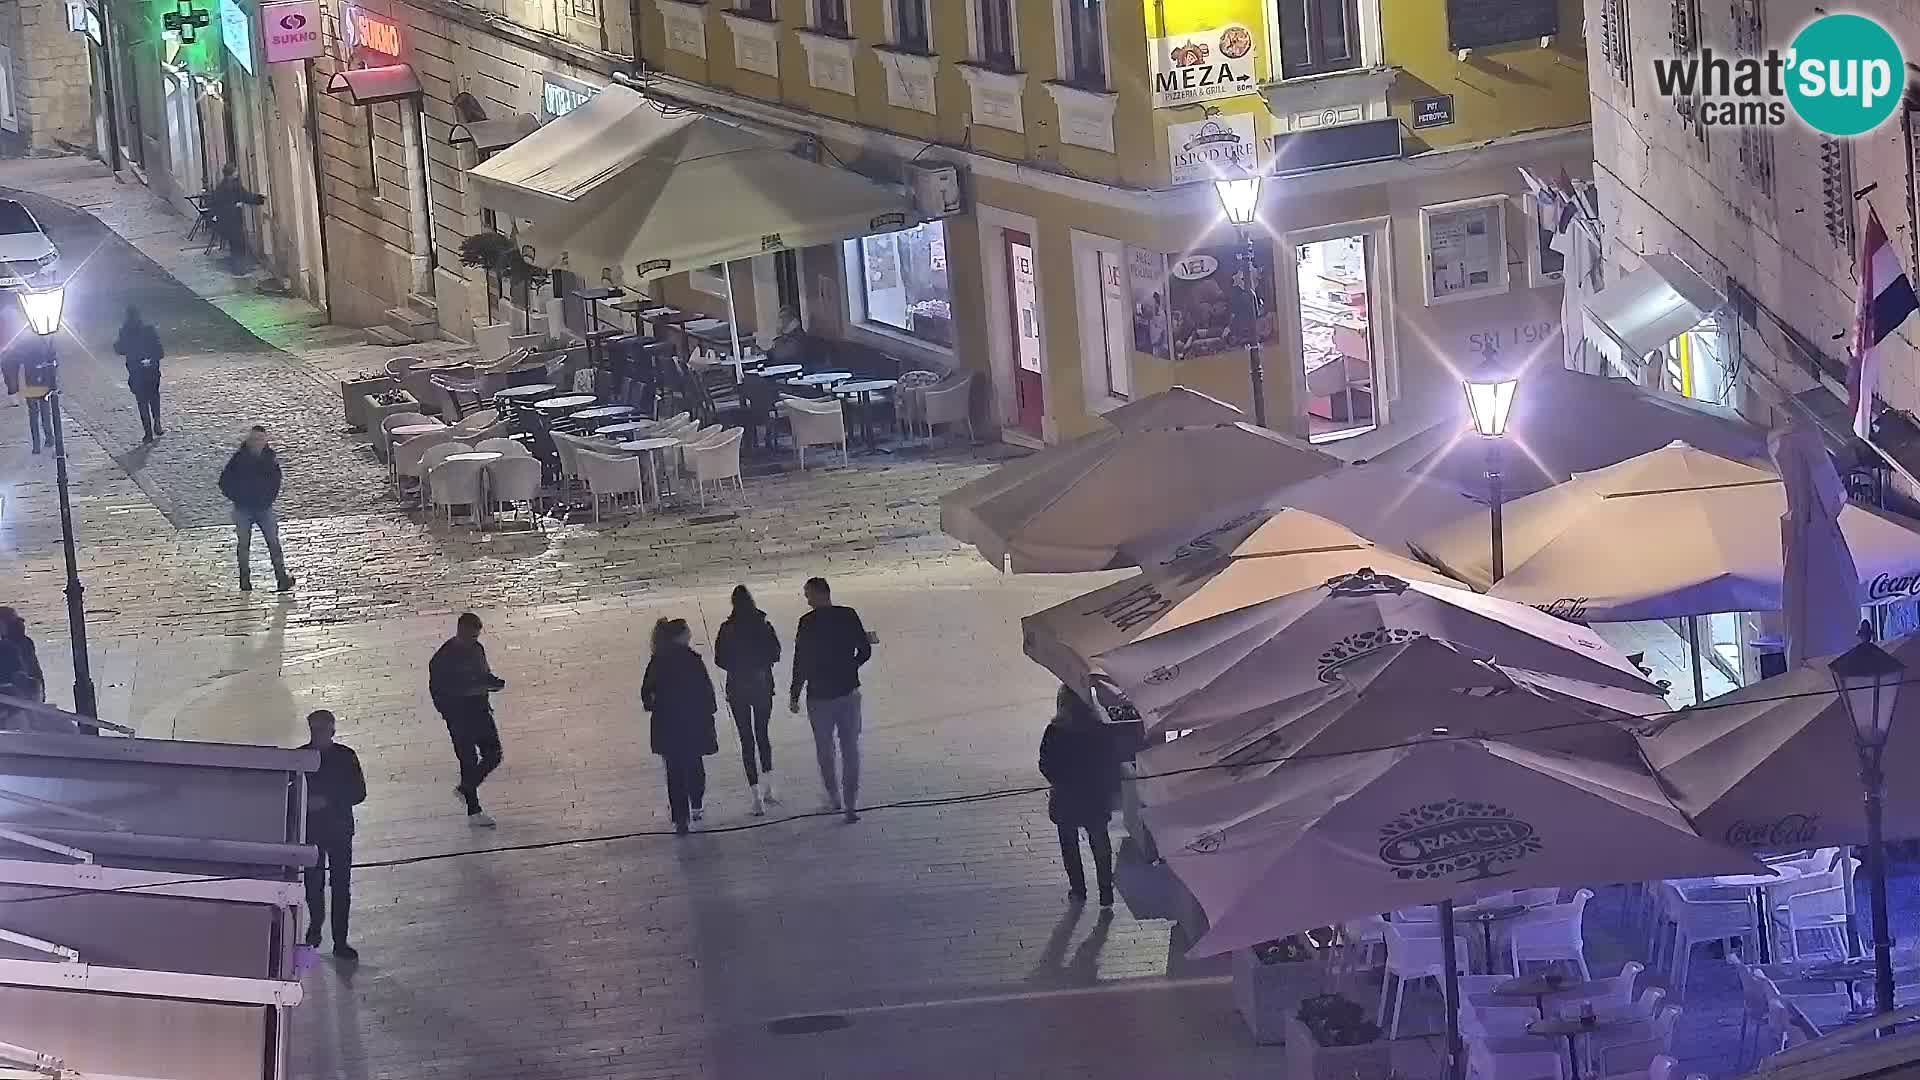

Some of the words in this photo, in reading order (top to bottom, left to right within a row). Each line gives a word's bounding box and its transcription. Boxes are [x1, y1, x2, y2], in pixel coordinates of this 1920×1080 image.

[271, 31, 317, 45] SUKNO
[1156, 63, 1235, 93] MEZA
[1165, 90, 1198, 101] PIZZERIA
[1206, 86, 1227, 97] GRILL
[1174, 148, 1220, 167] ISPOD
